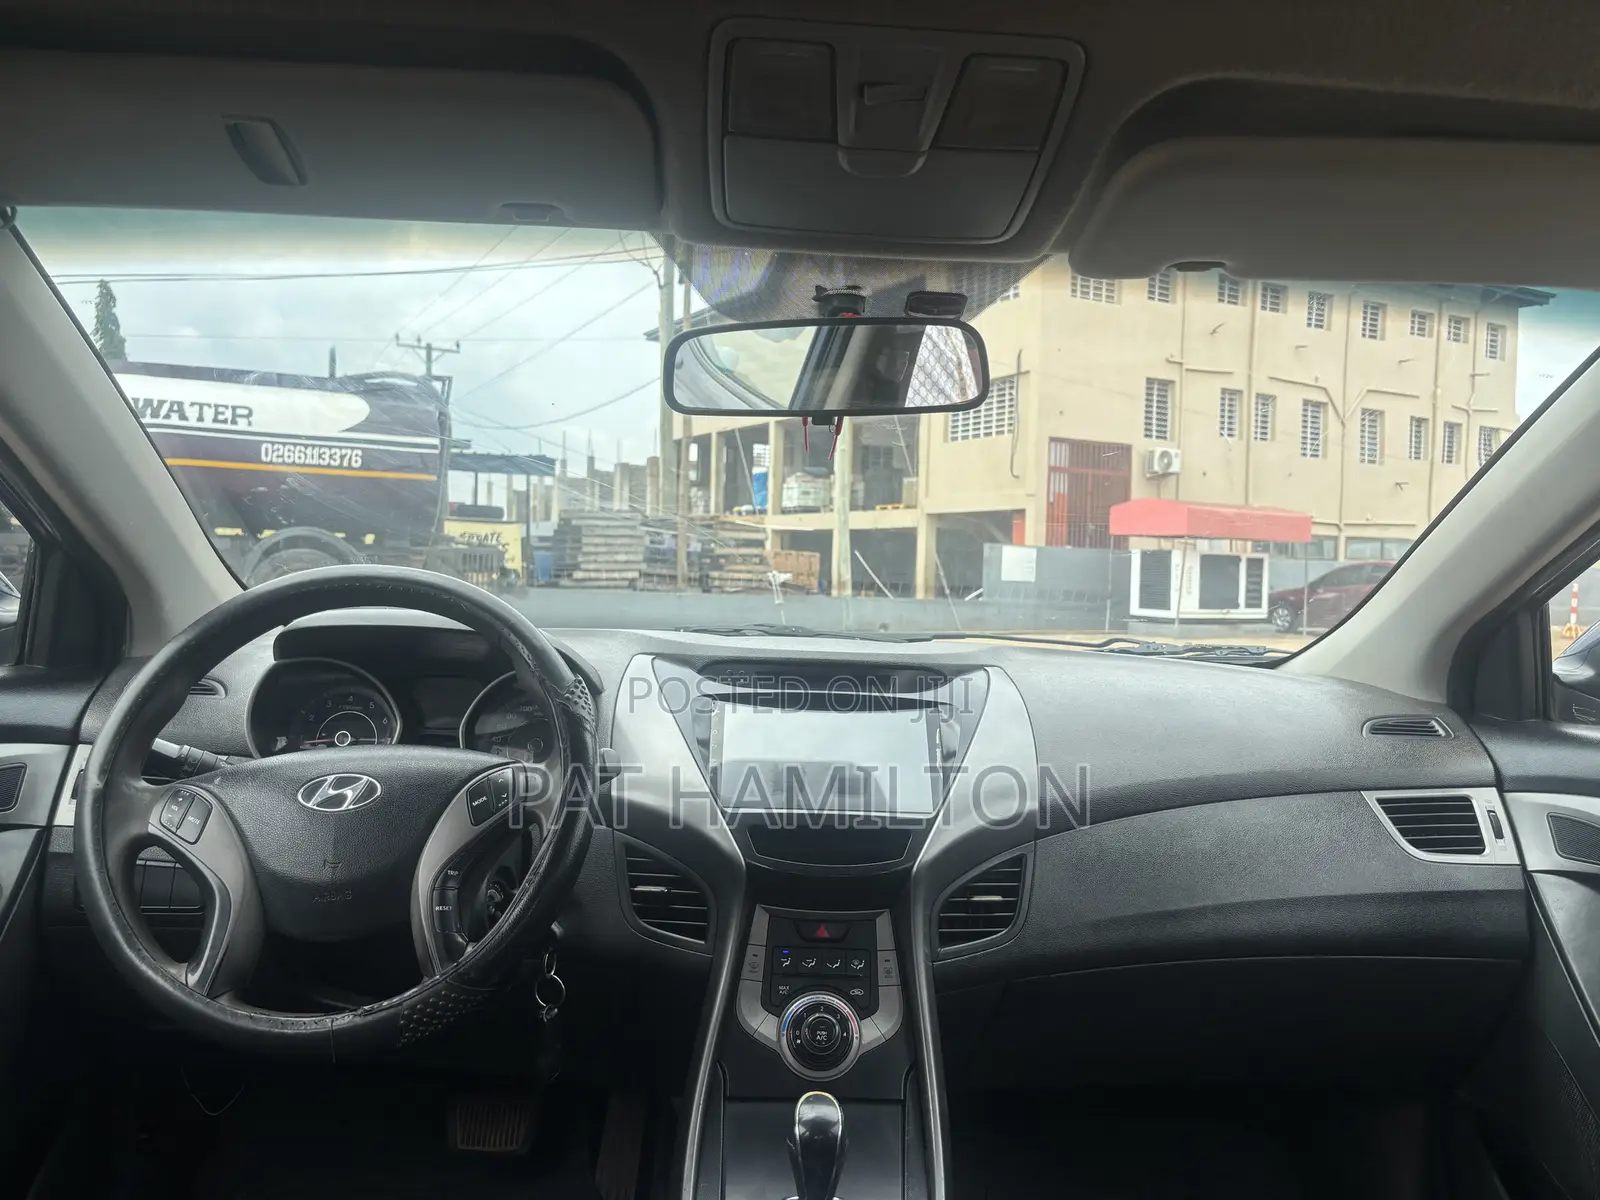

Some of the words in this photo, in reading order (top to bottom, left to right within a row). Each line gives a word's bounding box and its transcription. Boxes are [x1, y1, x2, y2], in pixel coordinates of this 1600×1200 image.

[131, 397, 253, 426] WATER
[261, 442, 362, 468] 0266113376
[382, 716, 388, 724] 6
[472, 796, 487, 807] MODE
[187, 815, 201, 825] MUTE
